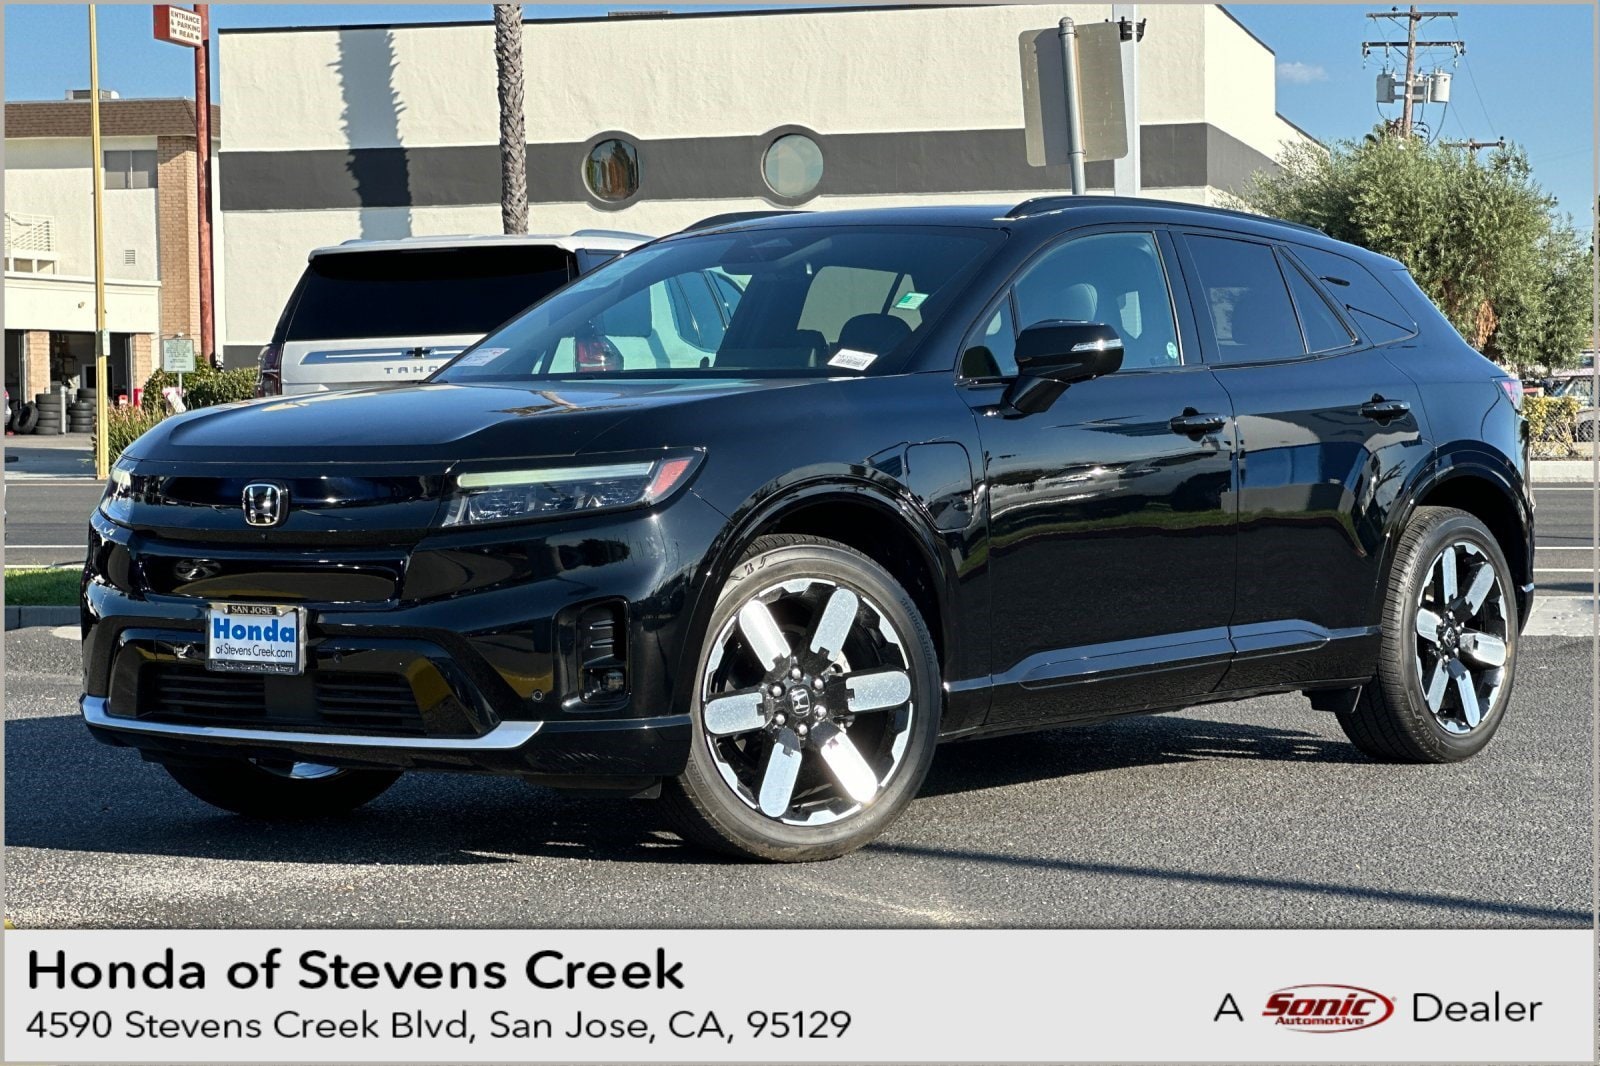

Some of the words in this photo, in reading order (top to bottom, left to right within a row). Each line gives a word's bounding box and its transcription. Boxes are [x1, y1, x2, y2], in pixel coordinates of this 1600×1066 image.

[170, 10, 200, 24] ENTRANCE
[177, 20, 200, 33] PARKING
[179, 29, 194, 39] REAR
[384, 365, 439, 375] TAHO
[231, 605, 249, 614] SAN
[250, 606, 273, 615] JOSE
[213, 618, 295, 643] Honda
[215, 645, 224, 654] of
[223, 642, 252, 656] Stevens
[252, 644, 293, 659] Creek.com
